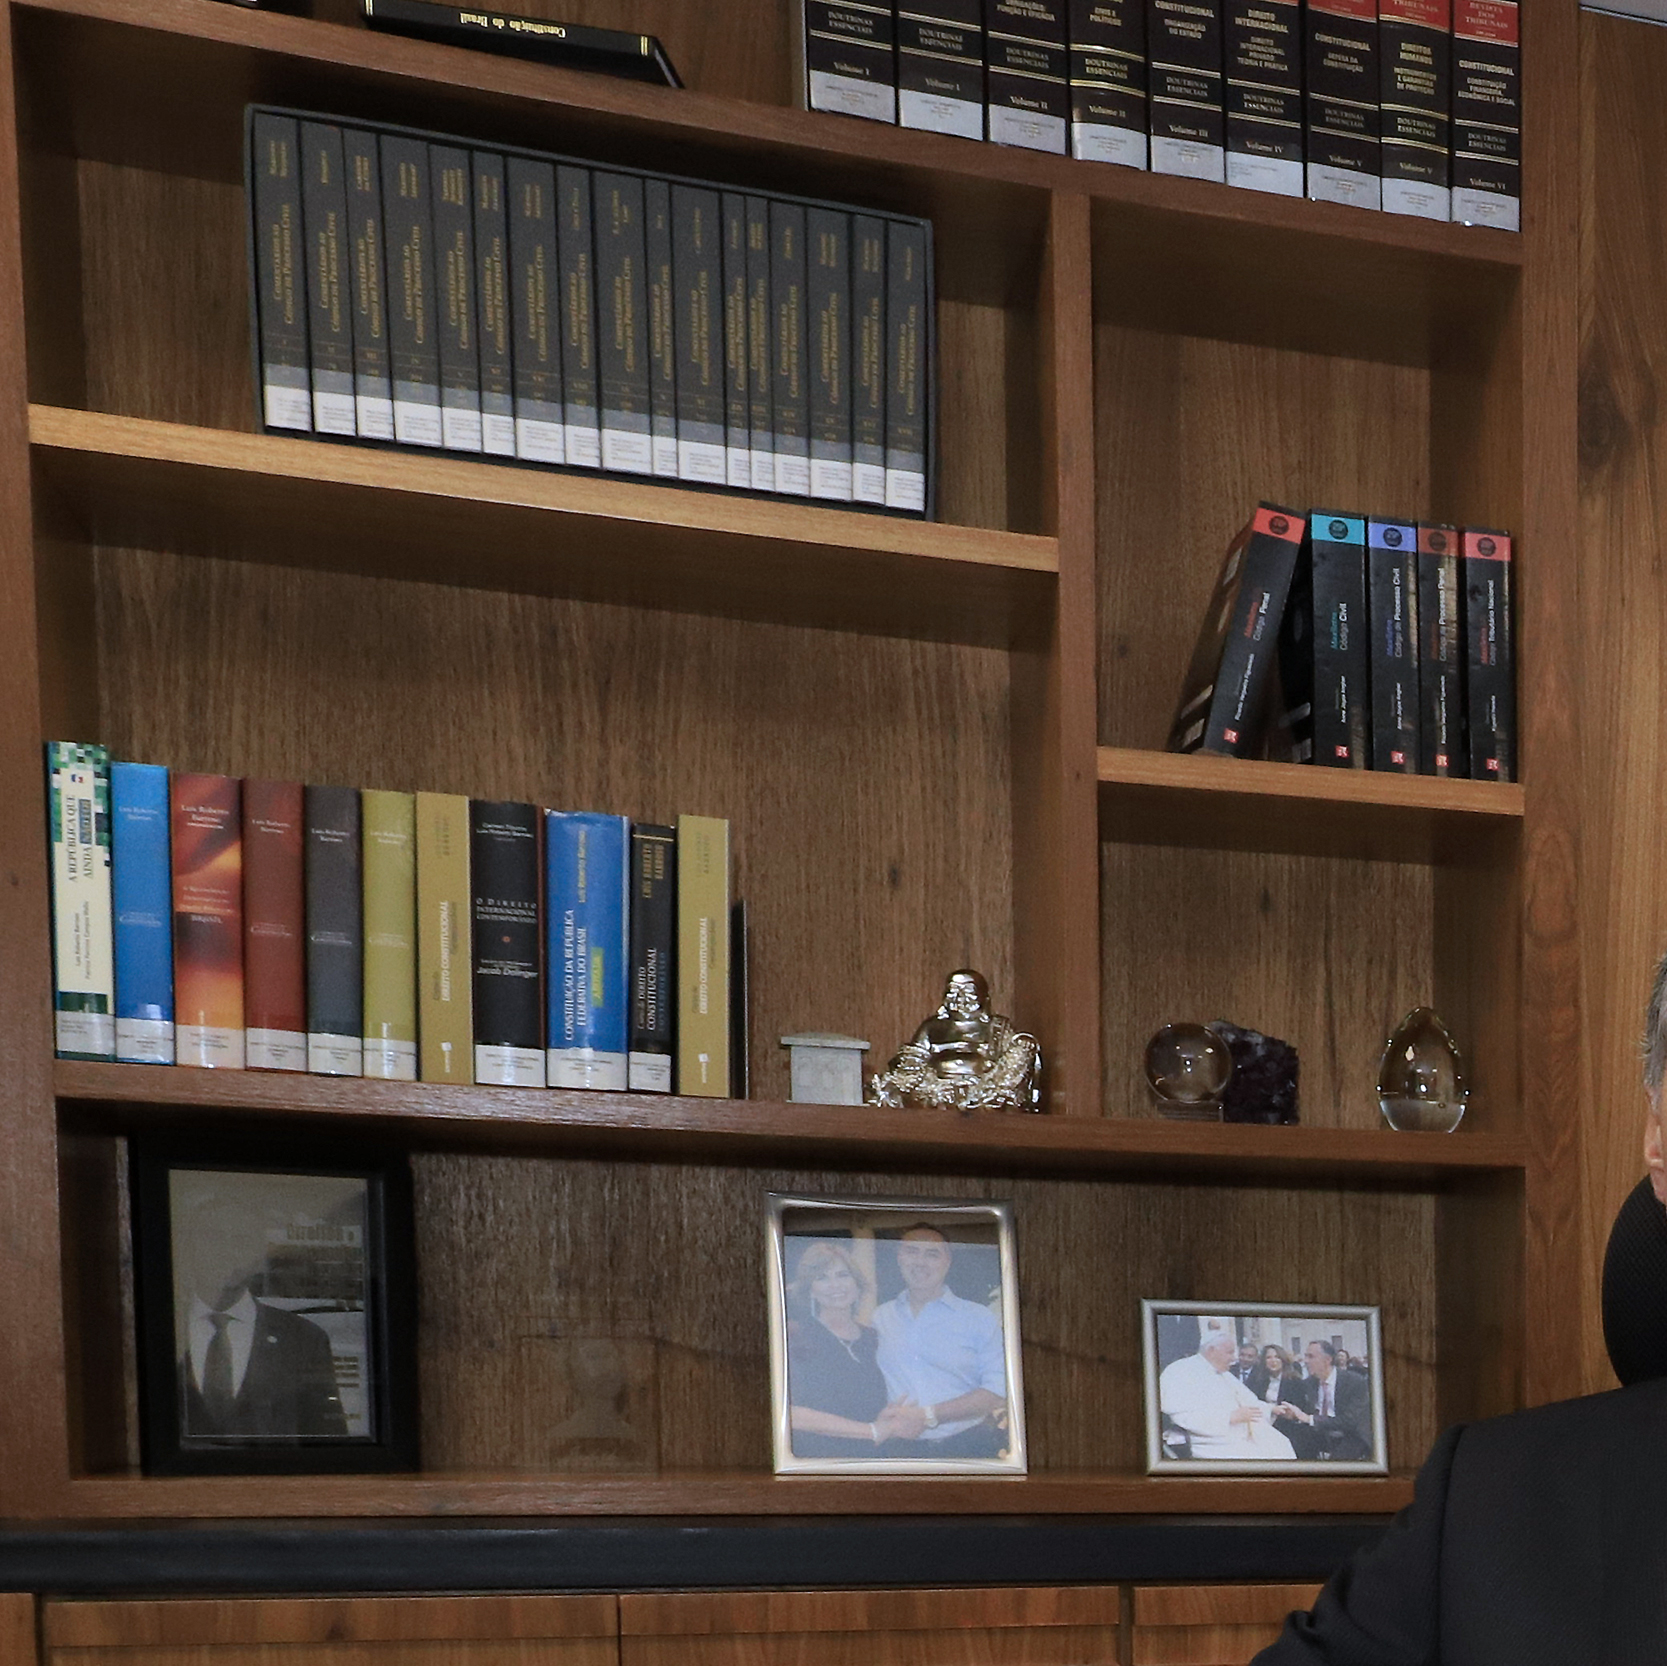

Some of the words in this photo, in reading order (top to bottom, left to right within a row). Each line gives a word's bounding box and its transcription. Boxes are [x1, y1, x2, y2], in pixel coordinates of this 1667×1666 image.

[1155, 1, 1215, 18] CONSTITUCIONAL
[1248, 9, 1275, 22] DIREITO
[1478, 11, 1495, 19] DOS
[460, 13, 488, 27] Brasil
[492, 18, 505, 29] do
[1235, 17, 1289, 33] INTERNACIONAL
[1466, 16, 1508, 29] TRIBUNAIS
[509, 19, 566, 38] Constituição
[1315, 33, 1371, 51] CONSTITUCIONAL
[1085, 58, 1128, 71] DOUTRINAS
[1085, 66, 1128, 79] ESSENCIAIS
[1459, 60, 1515, 76] CONSTITUCIONAL
[1166, 76, 1208, 89] DOUTRINAS
[1167, 85, 1208, 97] ESSENCIAIS
[1089, 105, 1118, 117] Volume
[1169, 124, 1198, 136] Volume
[1468, 132, 1507, 144] DOUTRINAS
[1468, 140, 1507, 152] ESSENCIAIS
[1469, 178, 1496, 189] Volume
[1392, 567, 1401, 584] Civil
[1259, 592, 1271, 614] Penal
[1394, 585, 1402, 621] Processo
[1339, 602, 1348, 621] Civil
[1339, 622, 1348, 651] Código
[66, 794, 76, 820] QUE
[67, 821, 78, 870] REPÚBLICA
[84, 846, 94, 879] AINDA
[69, 871, 78, 883] A
[440, 900, 449, 970] CONSTITUCIONAL
[563, 910, 575, 961] REPÚBLICA
[577, 927, 587, 959] BRASIL
[477, 966, 501, 976] Jacob
[503, 967, 538, 979] Dolinger
[565, 963, 573, 978] DA
[577, 960, 586, 973] DO
[637, 966, 646, 999] DIREITO
[647, 947, 657, 1031] CONSTITUCIONAL
[577, 974, 587, 1026] FEDERATIVA
[565, 980, 574, 1041] CONSTITUIÇÃO
